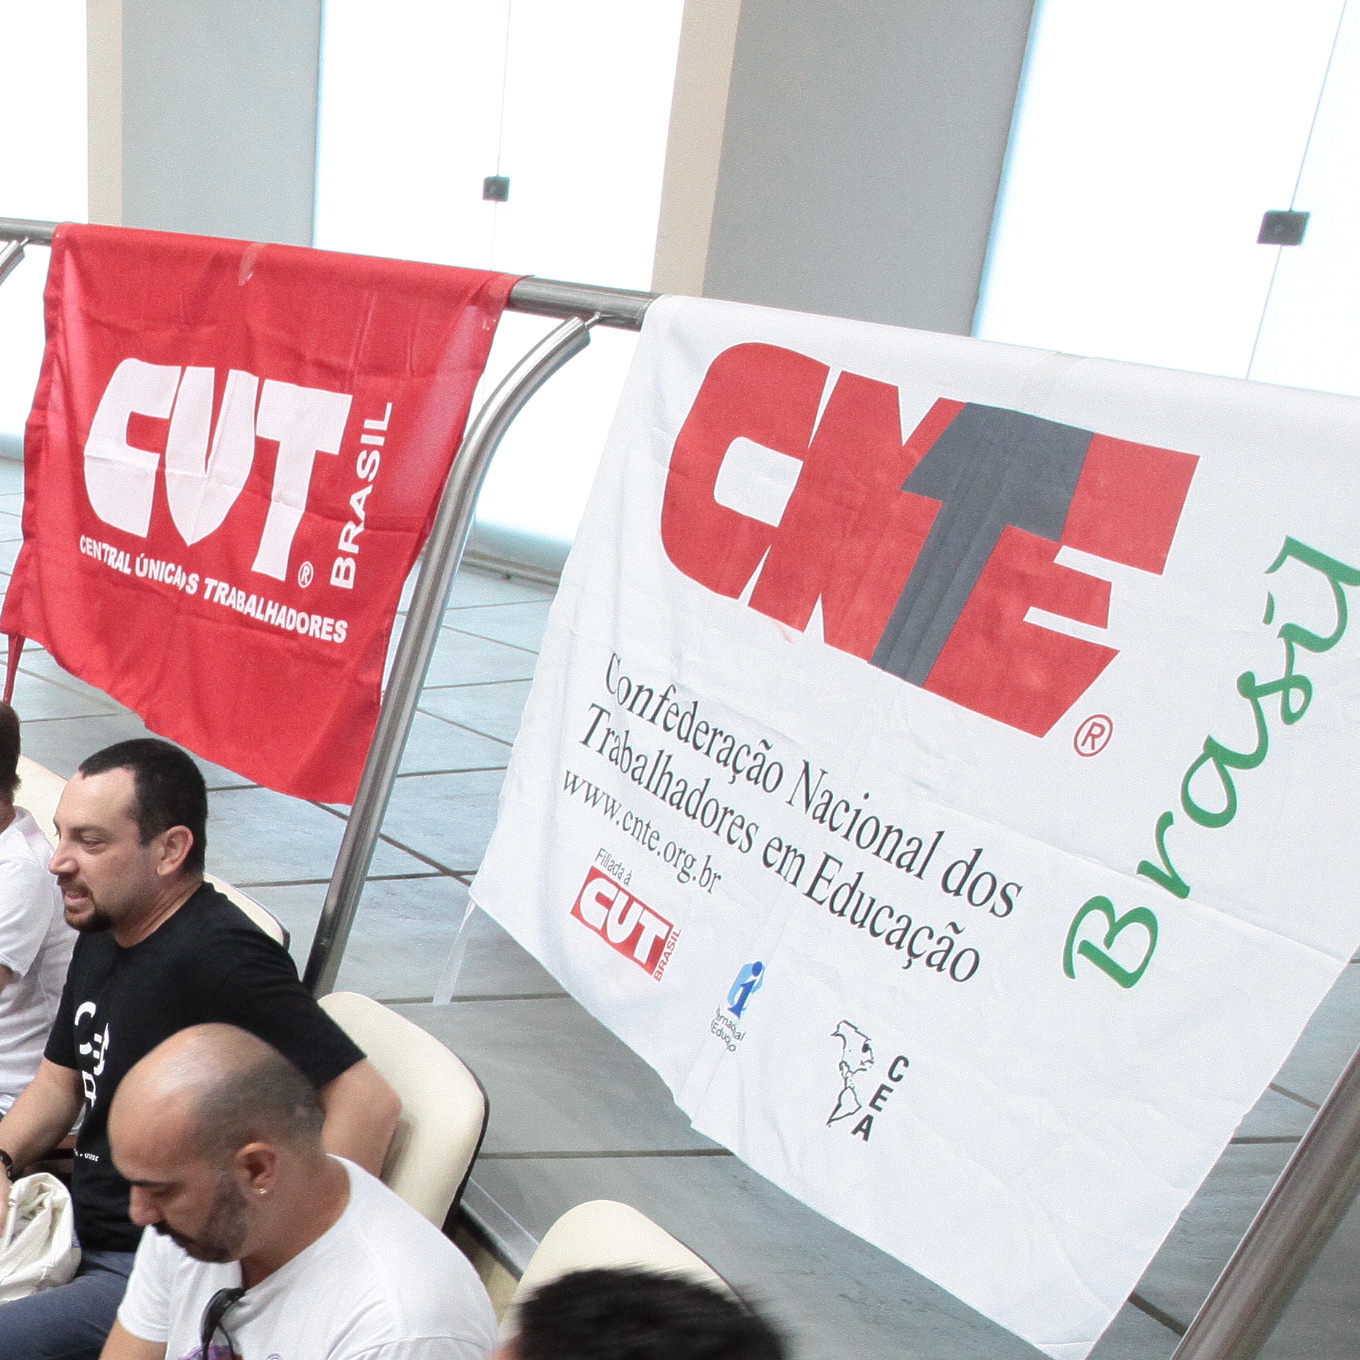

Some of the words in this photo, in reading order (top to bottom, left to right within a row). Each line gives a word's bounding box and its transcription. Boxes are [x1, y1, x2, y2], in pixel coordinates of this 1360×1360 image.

[83, 358, 353, 582] CUT
[330, 402, 392, 590] BRASIL
[660, 342, 1200, 739] CNTE
[80, 535, 132, 575] CENTRAL
[203, 577, 349, 644] TRABALHADORES
[563, 769, 722, 895] www.cnte.org.br
[579, 702, 760, 854] Trabalhadores
[761, 836, 806, 888] em
[802, 851, 981, 983] Educação
[605, 652, 784, 793] Confederação
[785, 759, 945, 881] Nacional
[941, 848, 1023, 918] dos
[1063, 535, 1360, 989] Brasil
[580, 877, 671, 965] CUT
[594, 848, 624, 881] Filiada
[653, 928, 682, 982] BRASIL
